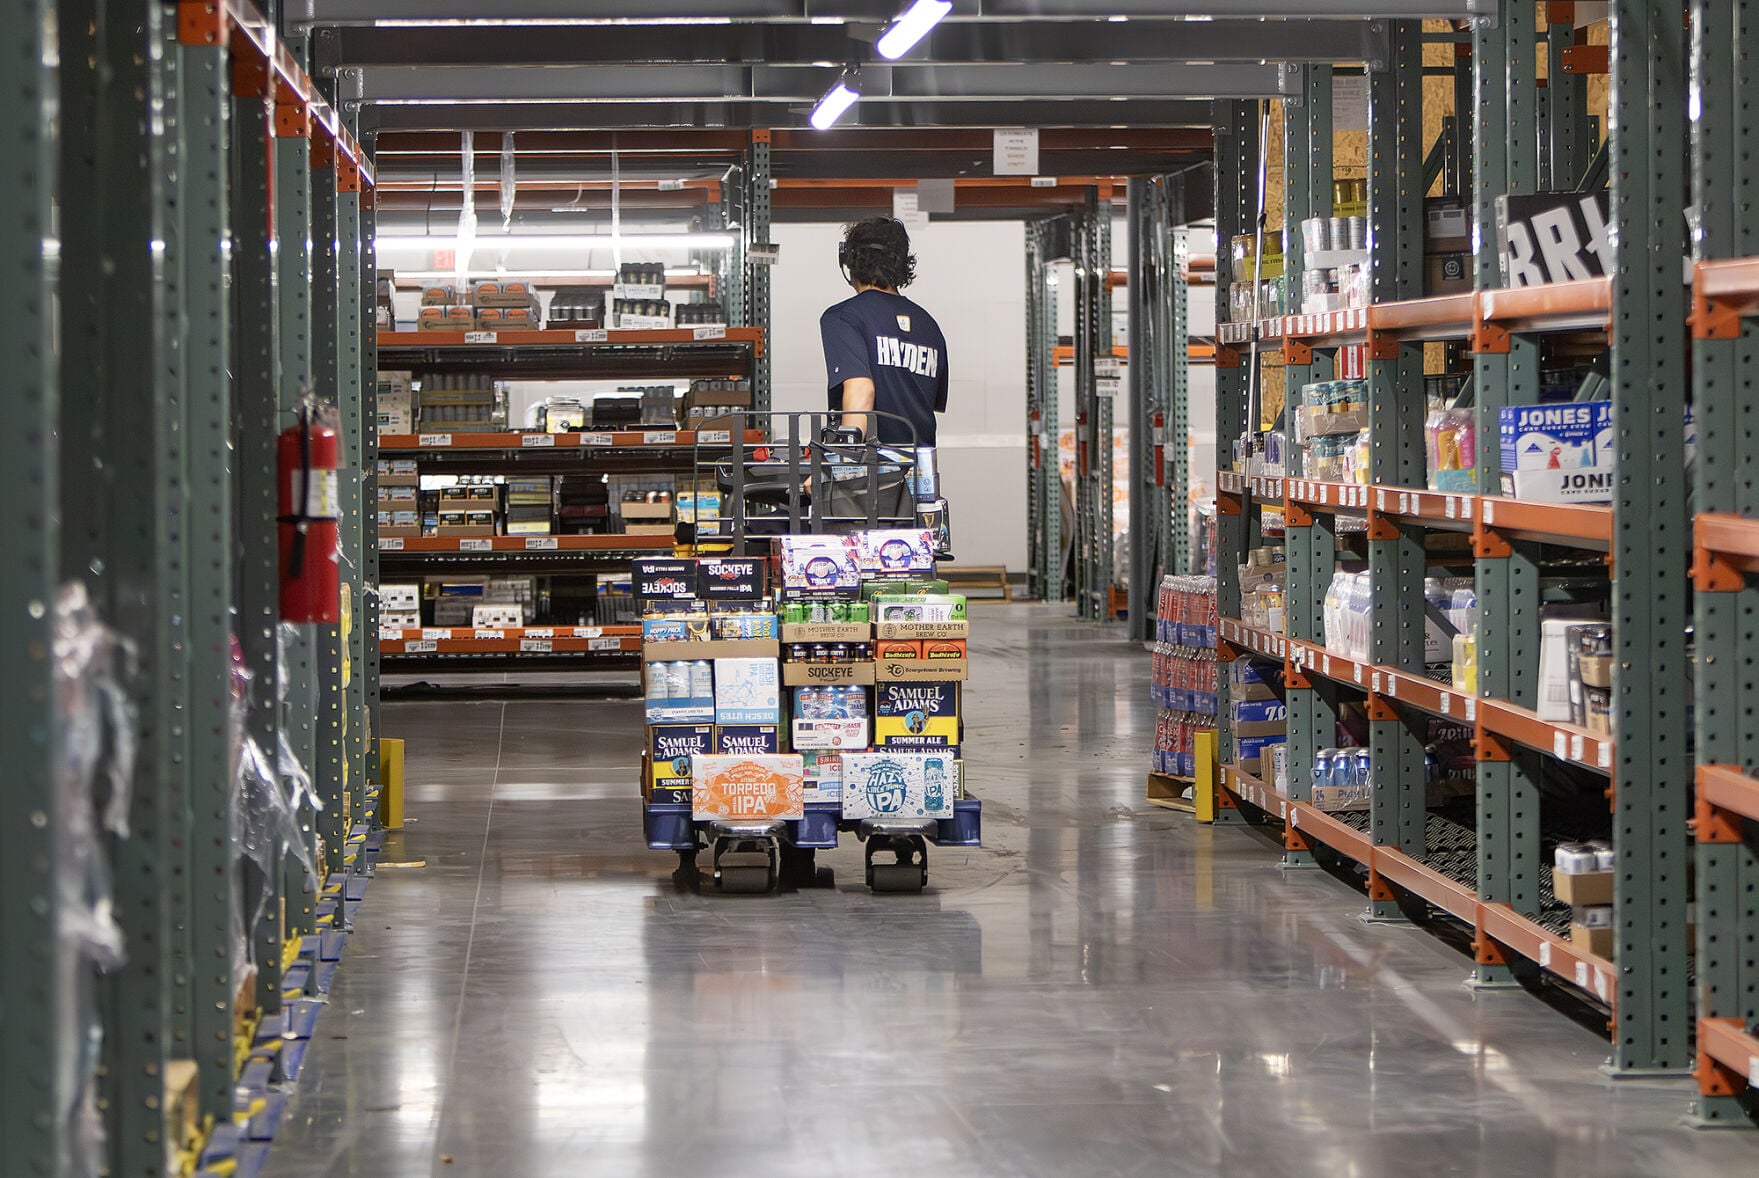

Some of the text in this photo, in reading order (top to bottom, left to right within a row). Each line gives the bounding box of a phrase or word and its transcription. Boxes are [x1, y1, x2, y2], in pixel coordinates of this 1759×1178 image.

[1518, 407, 1591, 427] JONES
[642, 565, 655, 574] IPA
[708, 564, 753, 575] SOCKEYE
[642, 582, 687, 594] SOCKEYE
[739, 584, 753, 592] IPA
[900, 623, 964, 631] MOTHER EARTH
[749, 663, 758, 677] IPA
[807, 667, 853, 678] SOCKEYE
[888, 686, 945, 701] SAMUEL
[892, 698, 940, 714] ADAMS
[658, 735, 705, 749] SAMUEL
[722, 735, 769, 749] SAMUEL
[891, 736, 942, 744] SUMMER ALE
[662, 747, 701, 759] ADAMS
[727, 747, 765, 755] ADAMS
[661, 778, 690, 786] SUMMER
[869, 772, 903, 787] HAZY
[721, 782, 776, 796] TORPEDO
[737, 795, 767, 814] IPA
[868, 789, 903, 812] IPA
